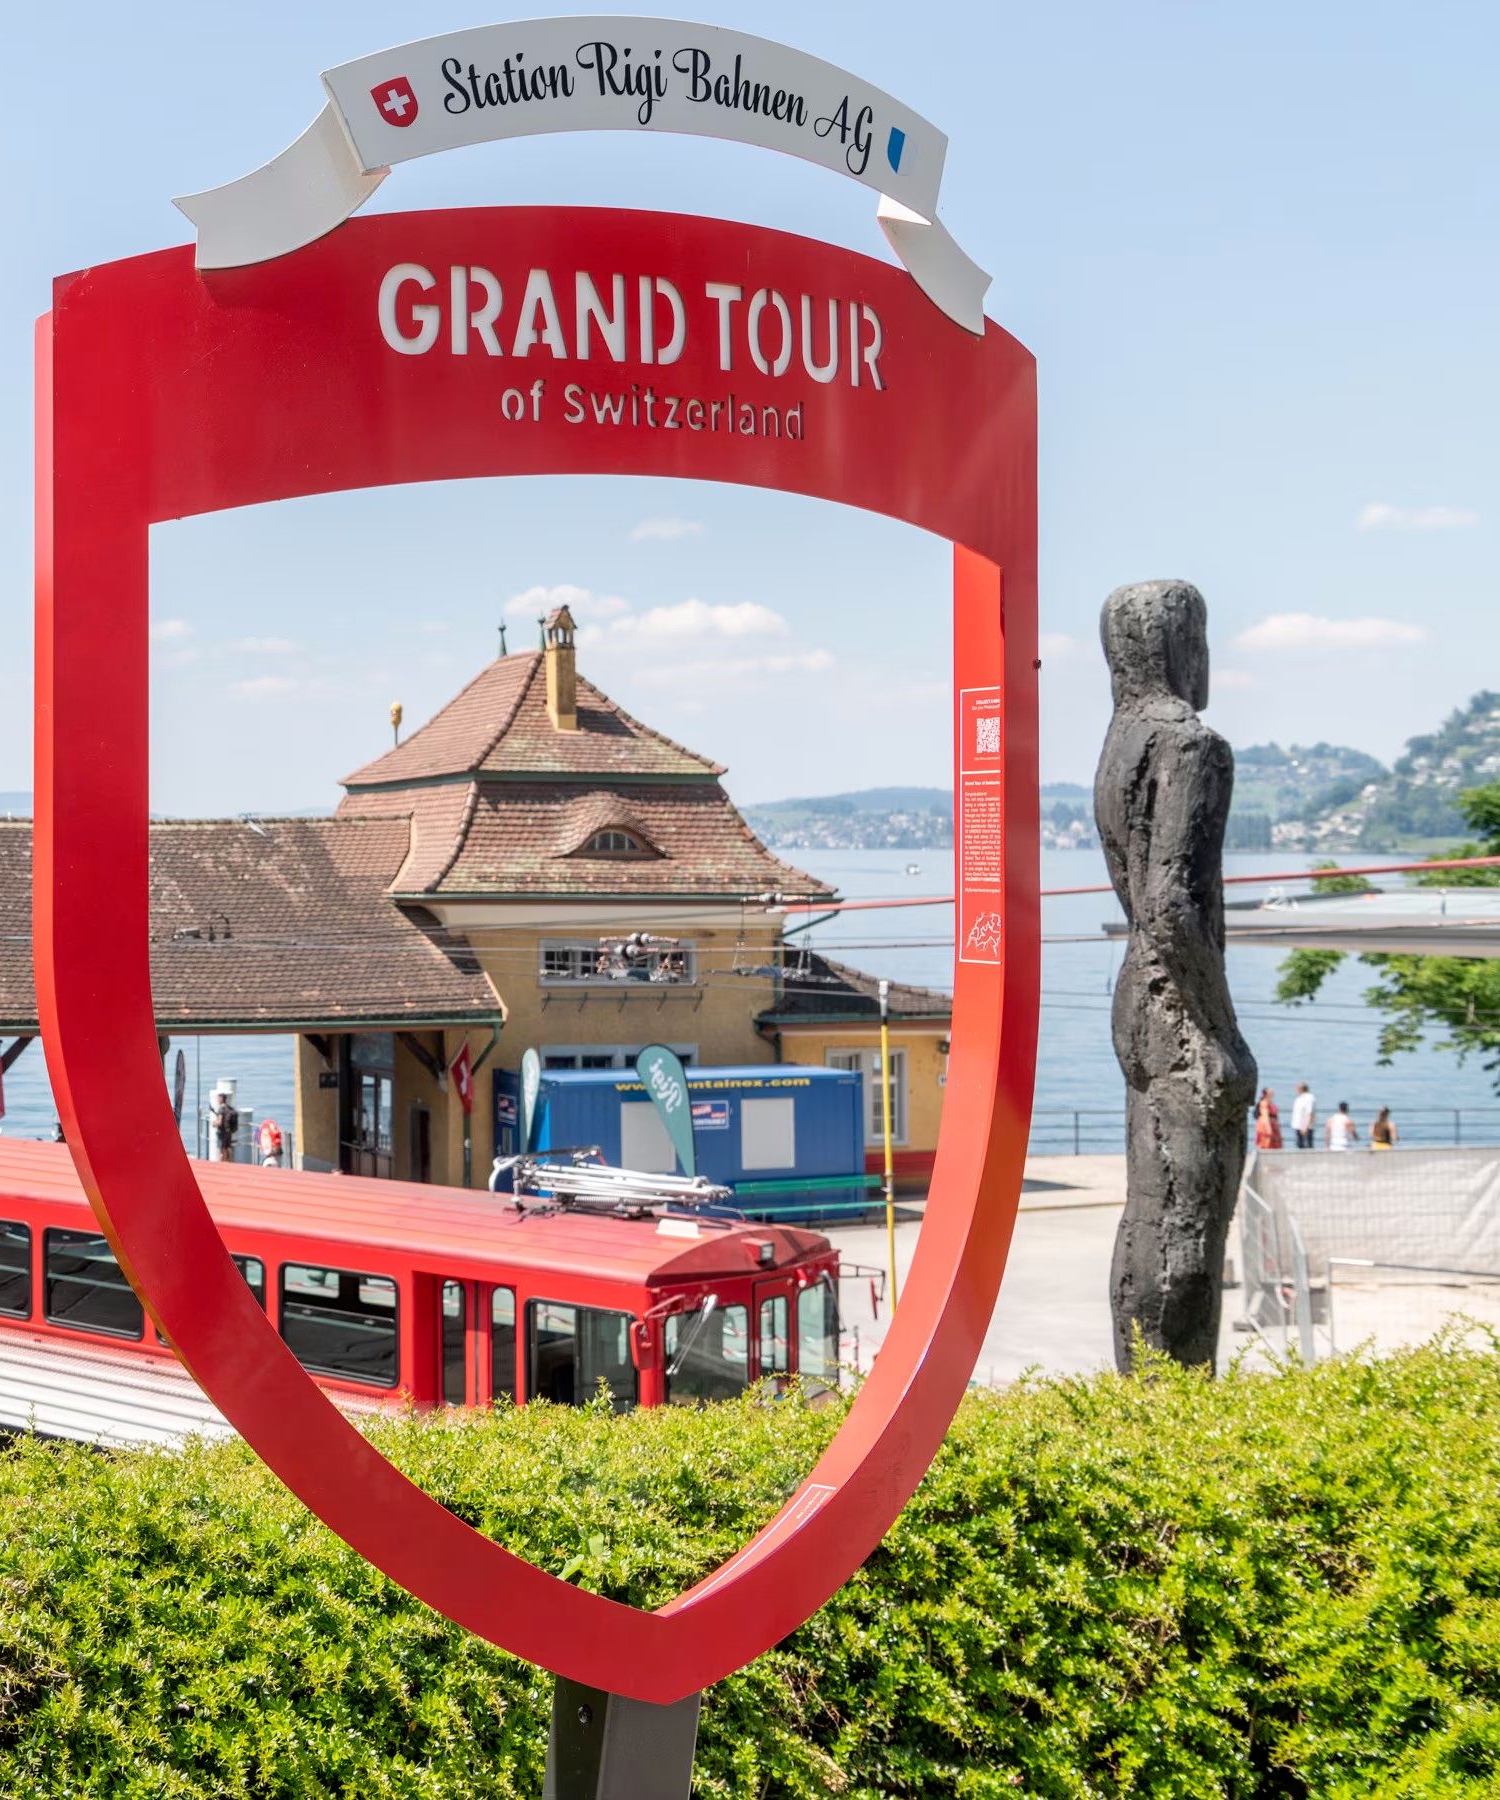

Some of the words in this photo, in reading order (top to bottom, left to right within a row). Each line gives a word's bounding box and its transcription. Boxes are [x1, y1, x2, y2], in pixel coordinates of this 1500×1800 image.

[441, 52, 574, 115] Station
[575, 41, 668, 125] Rigi
[672, 48, 808, 127] Bahnen
[813, 95, 875, 175] AG
[378, 263, 686, 365] GRAND
[704, 282, 887, 391] TOUR
[500, 379, 545, 421] of
[563, 383, 805, 440] Switzerland
